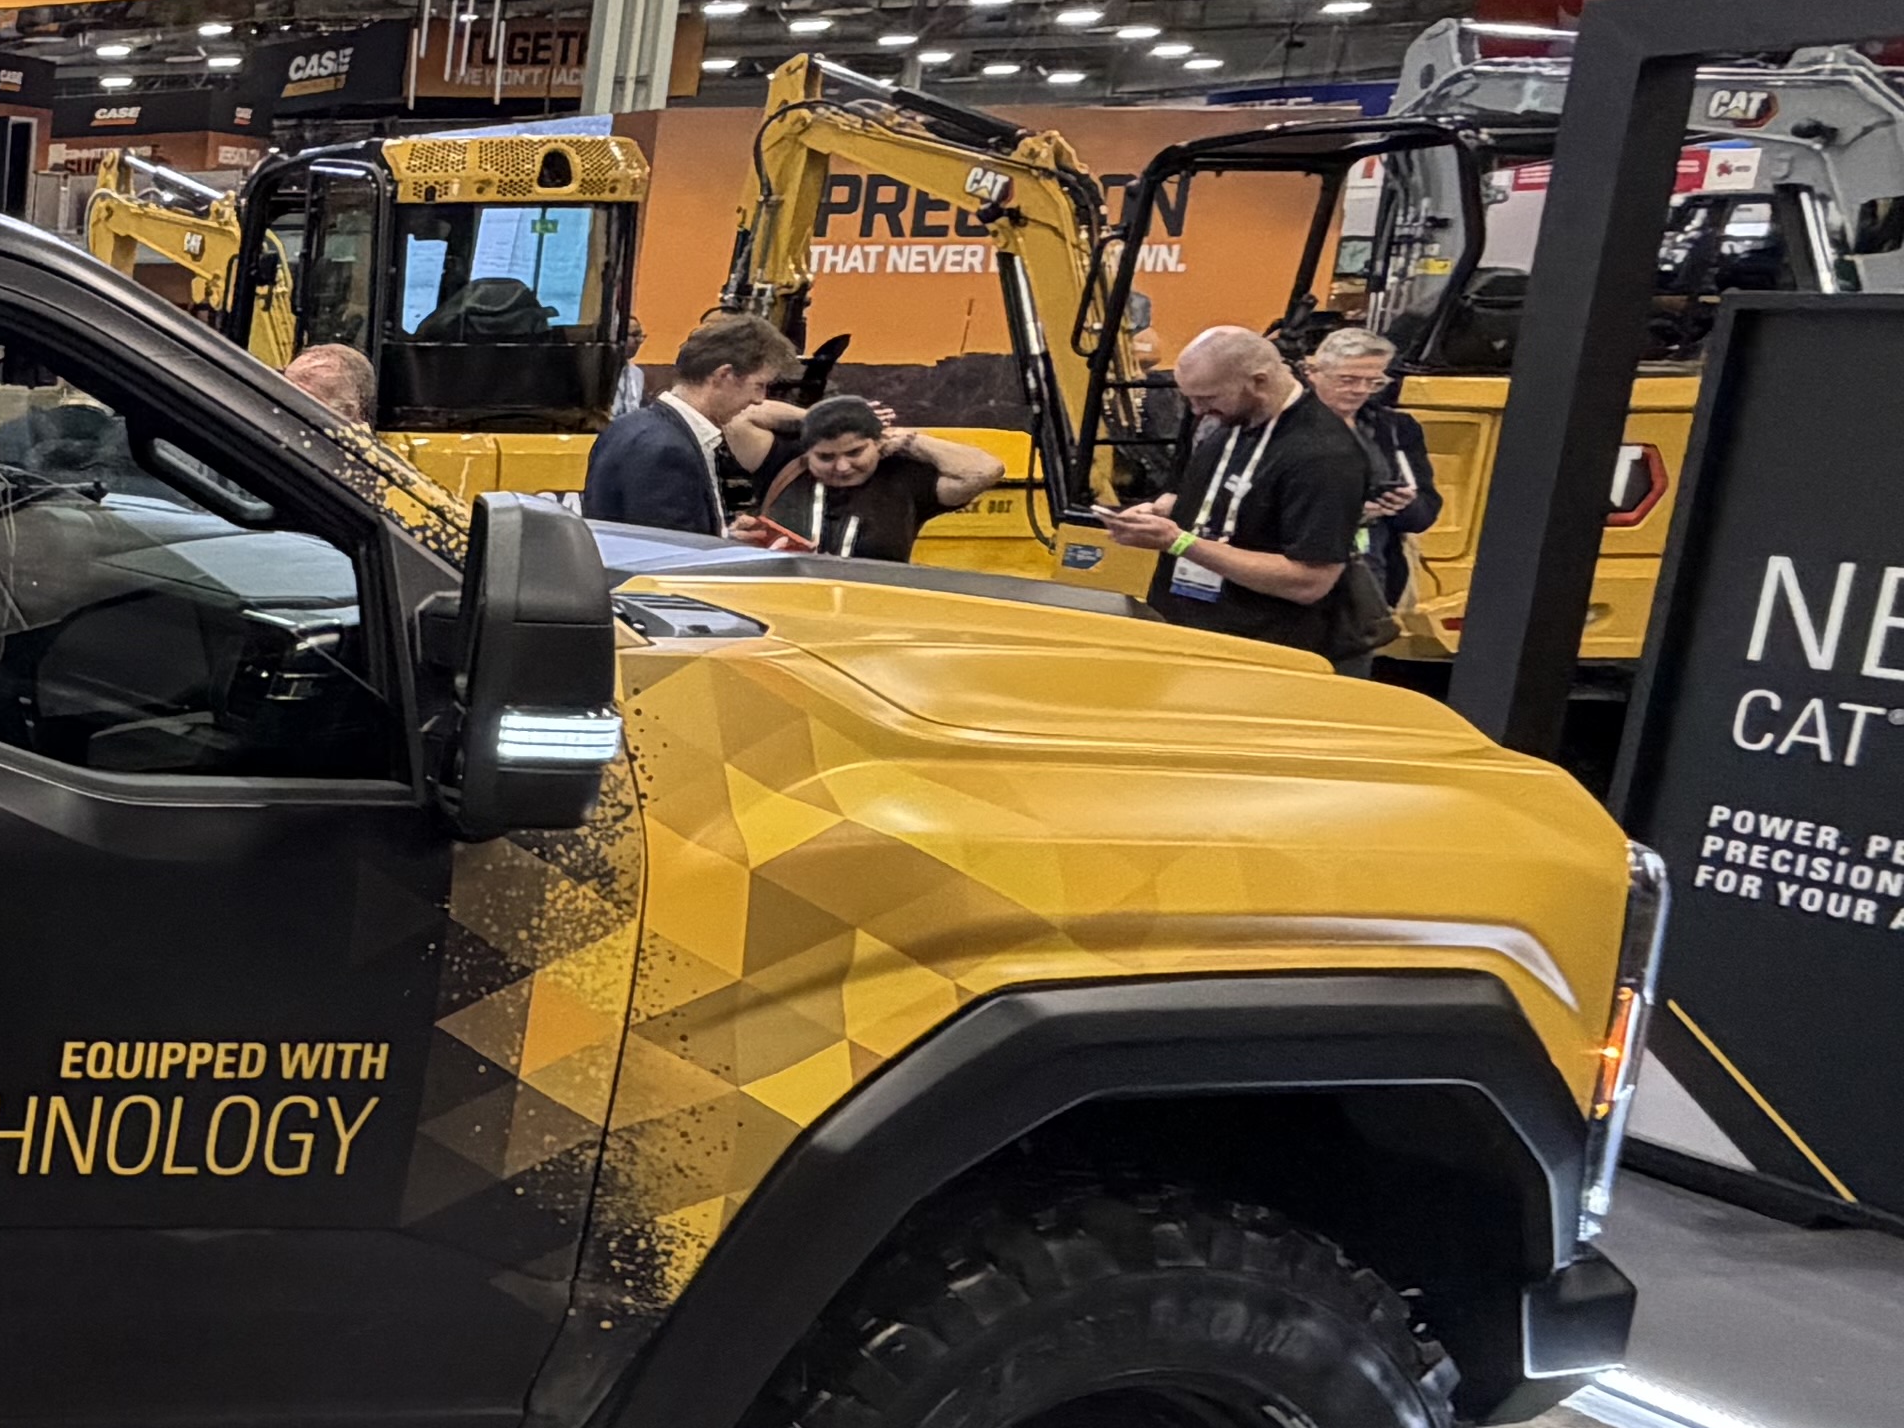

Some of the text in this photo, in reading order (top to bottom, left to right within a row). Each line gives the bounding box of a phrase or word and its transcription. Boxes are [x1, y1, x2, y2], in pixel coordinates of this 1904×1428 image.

[288, 47, 355, 81] CASE
[94, 106, 142, 121] CASE
[1708, 89, 1769, 120] CAT
[963, 166, 1010, 201] CAT
[809, 244, 886, 273] THAT
[886, 244, 984, 273] NEVER
[1693, 863, 1764, 901] FOR
[1777, 880, 1881, 926] YOUR
[60, 1041, 390, 1080] EQUIPPED WITH
